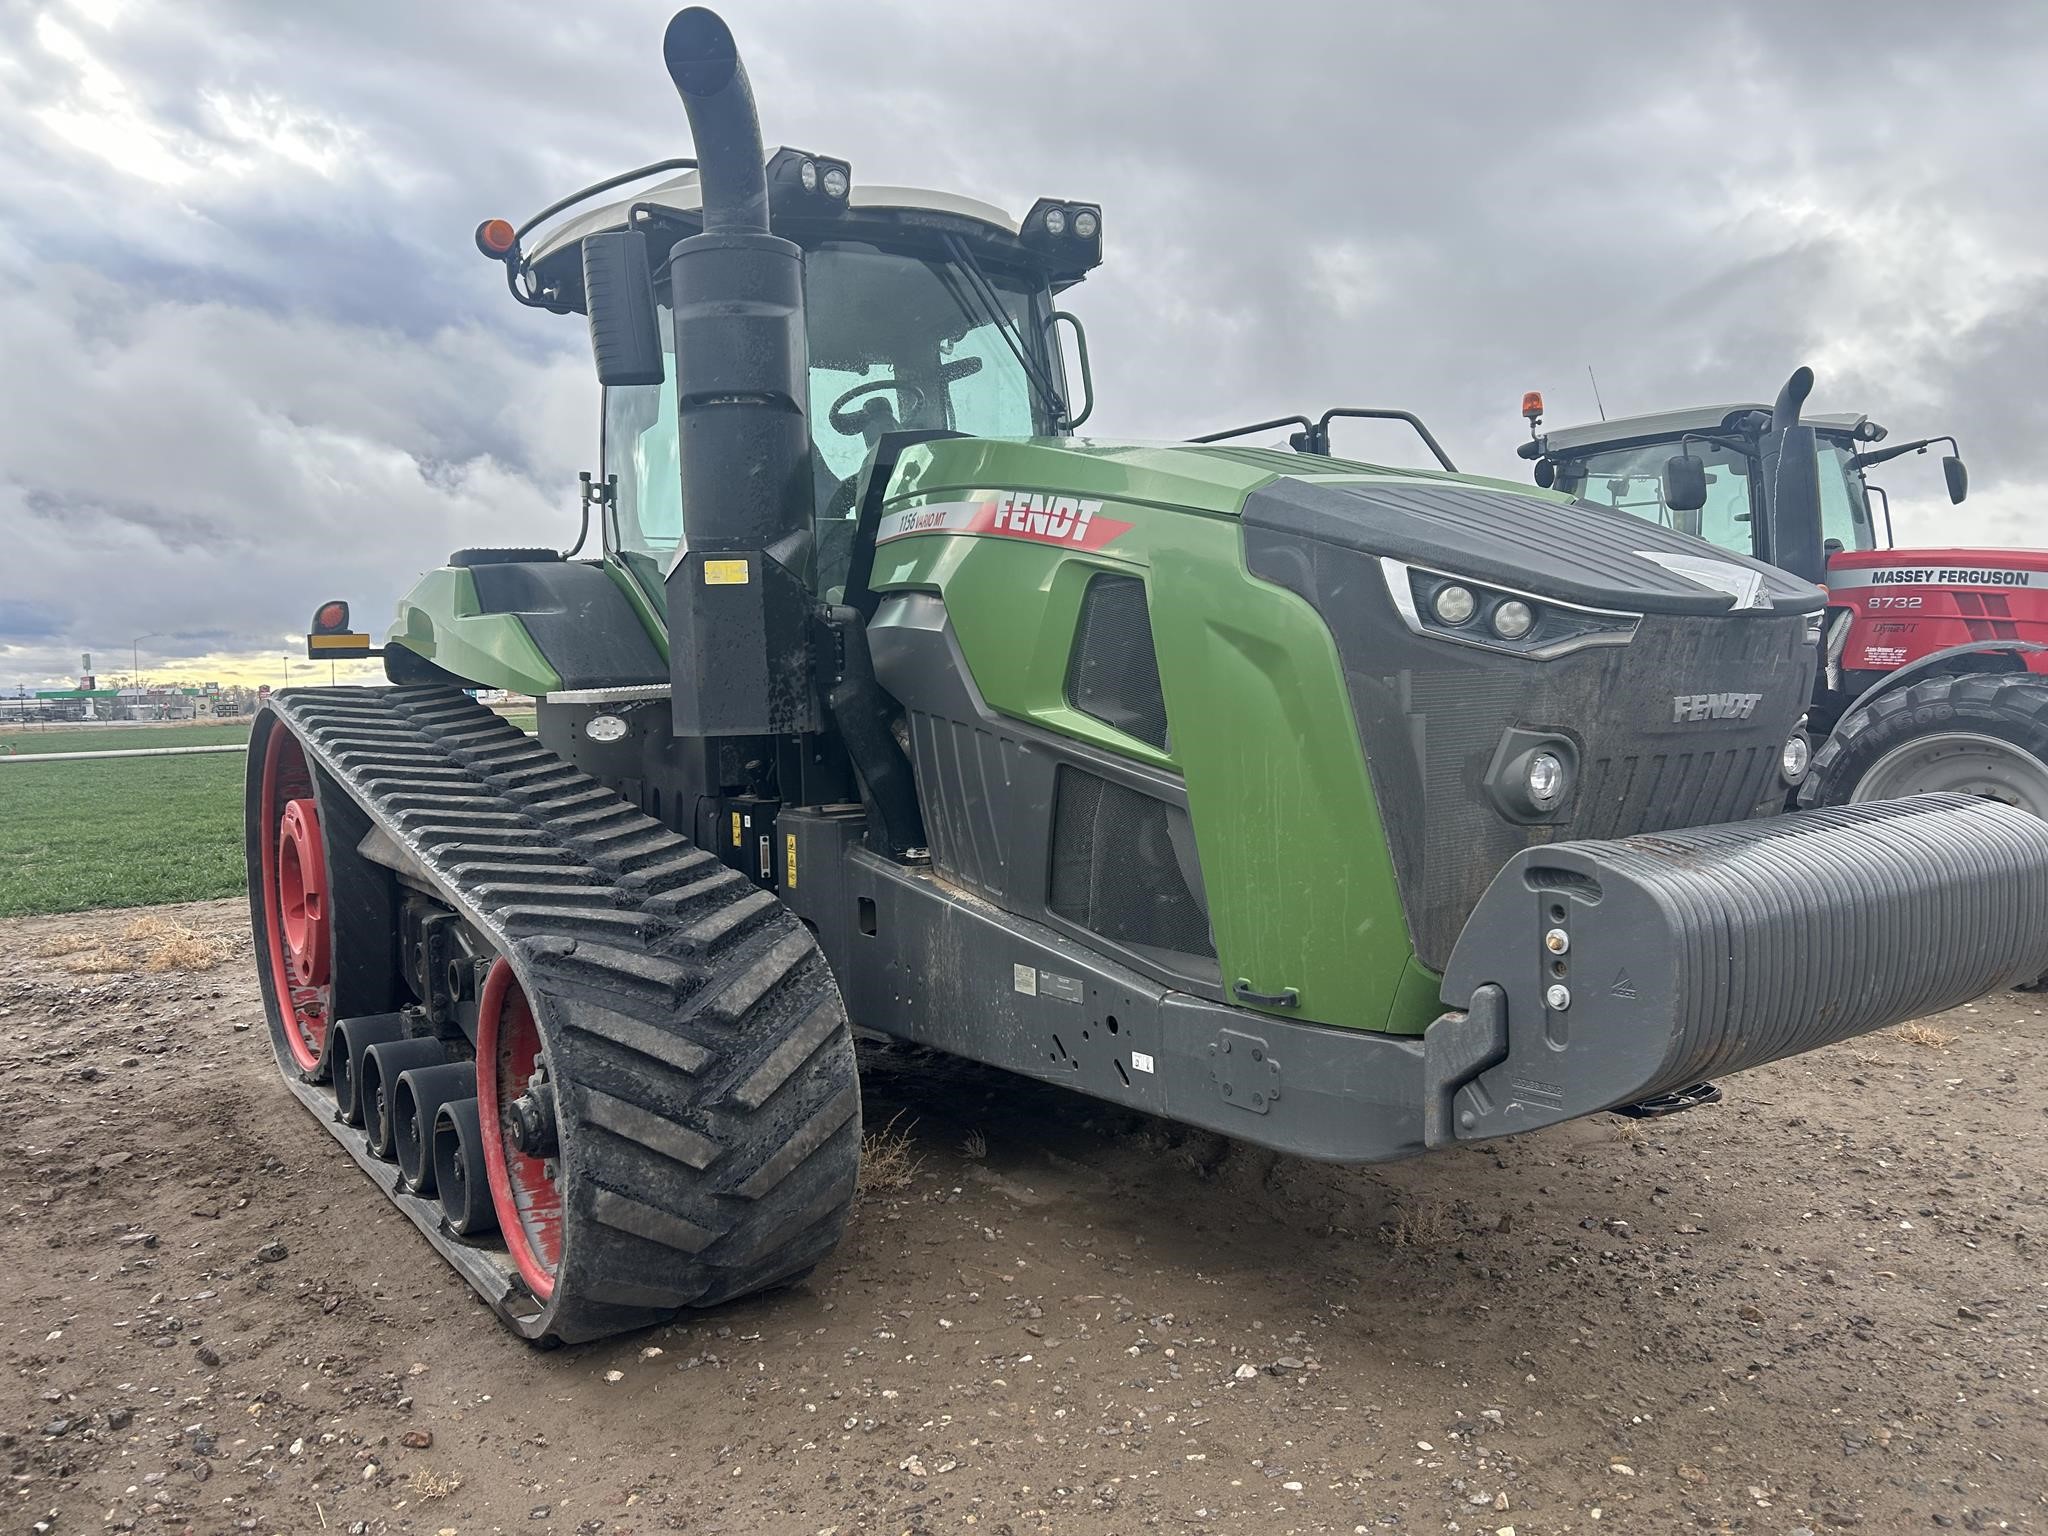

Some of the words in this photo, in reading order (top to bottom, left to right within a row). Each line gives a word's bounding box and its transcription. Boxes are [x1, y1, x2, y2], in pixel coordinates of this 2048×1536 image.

[898, 512, 917, 532] 1156
[915, 512, 935, 529] VARIO
[934, 511, 947, 527] MT
[994, 491, 1103, 541] FENDT
[1872, 570, 1934, 584] MASSEY
[1938, 570, 2029, 585] FERGUSON
[1868, 597, 1922, 609] 8732
[1672, 692, 1763, 722] FENDT
